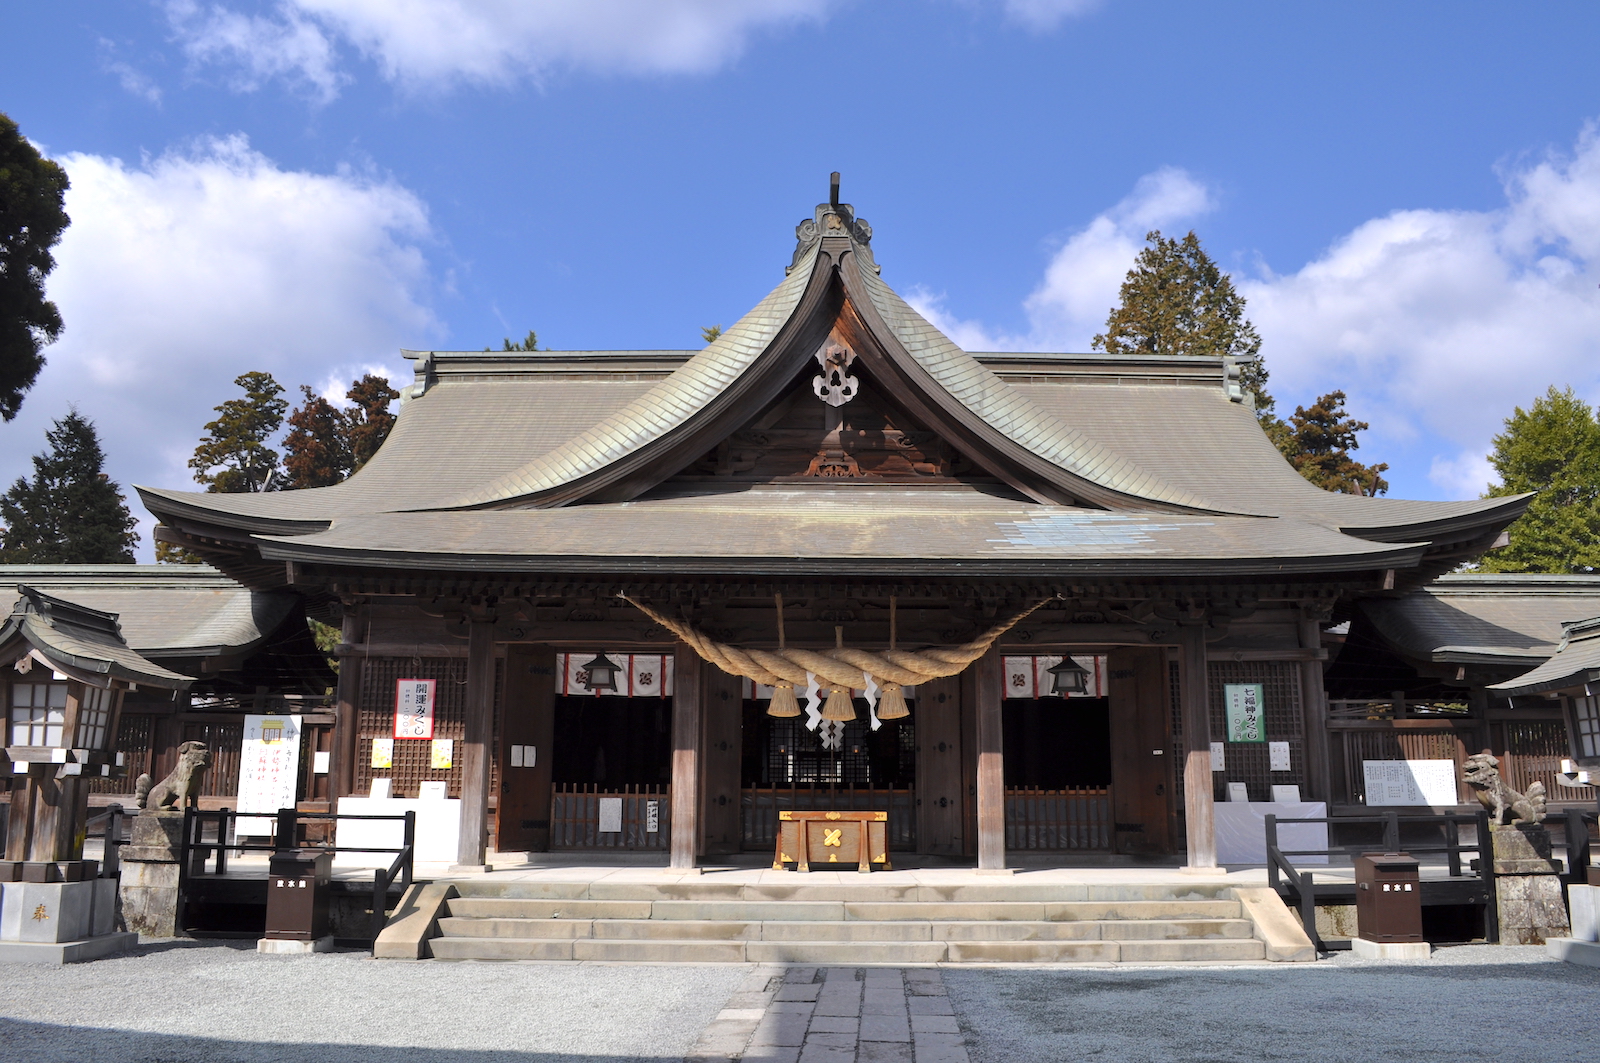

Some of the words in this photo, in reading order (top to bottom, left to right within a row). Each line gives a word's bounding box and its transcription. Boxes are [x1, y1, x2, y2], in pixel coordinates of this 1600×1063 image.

[414, 683, 428, 736] 開運みくじ
[1243, 687, 1257, 740] 七福神みくじ
